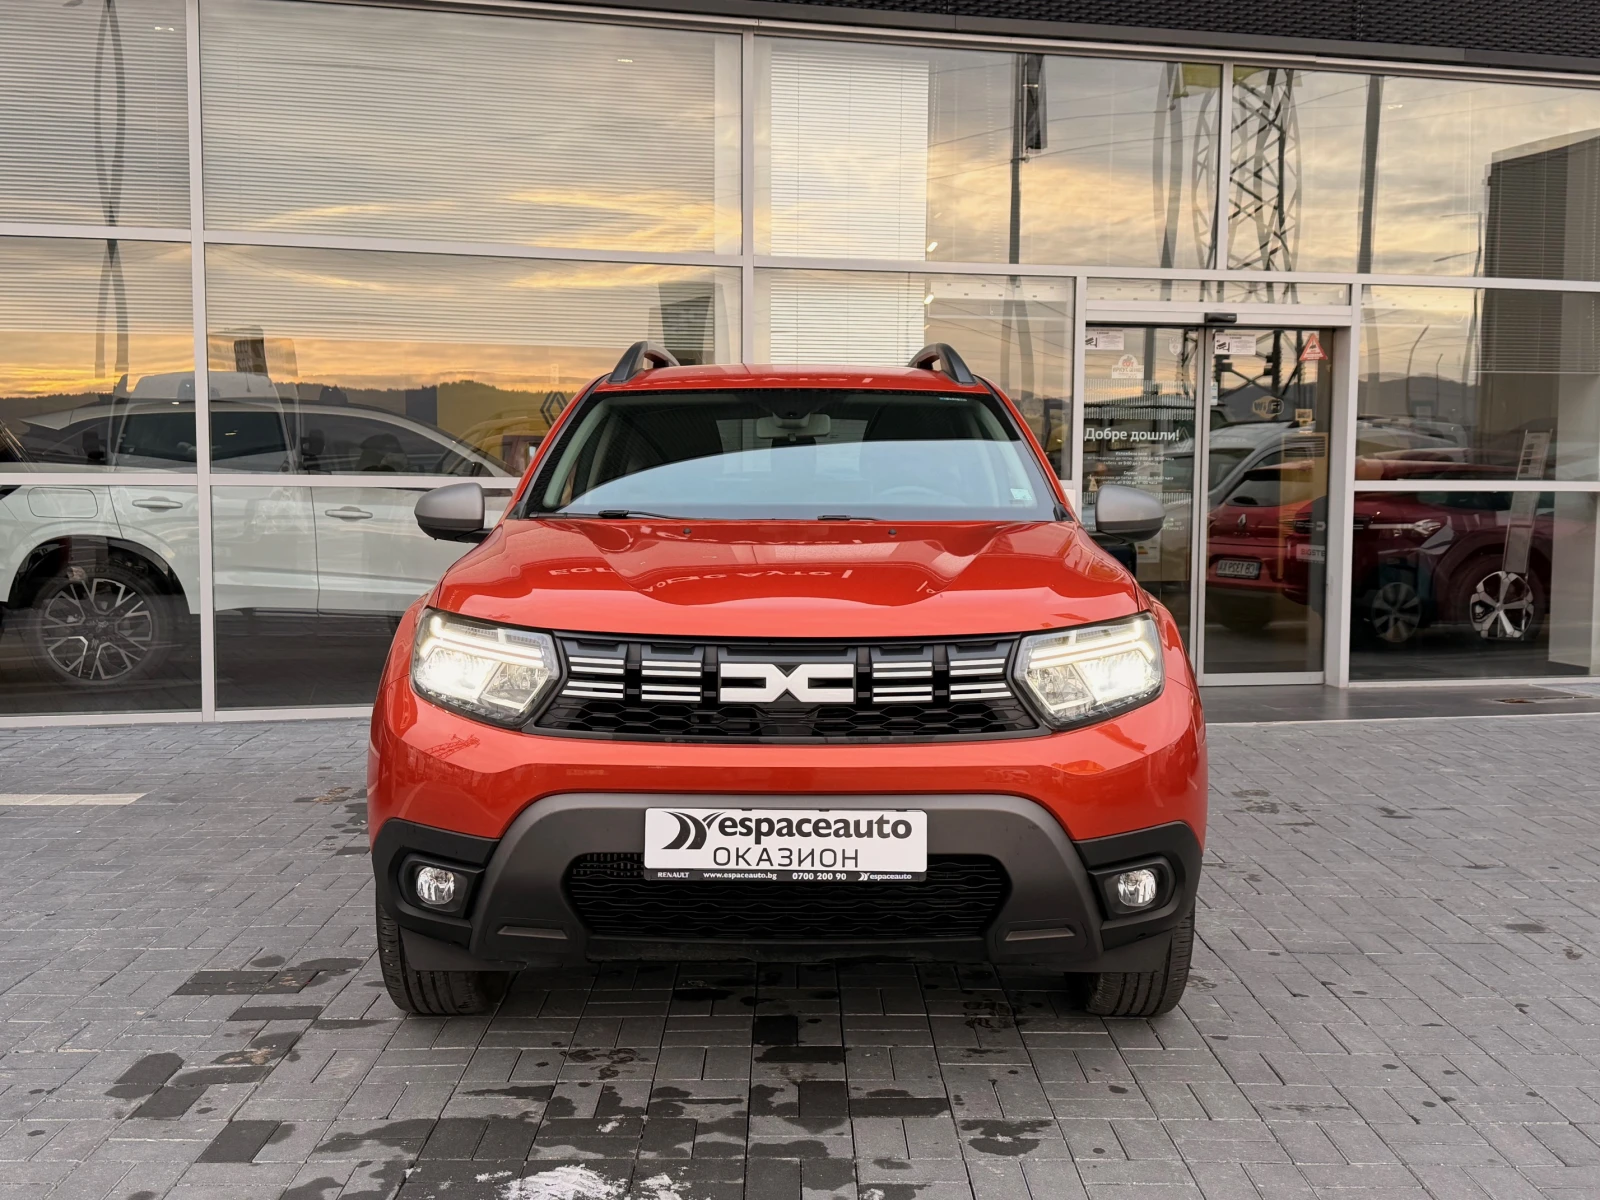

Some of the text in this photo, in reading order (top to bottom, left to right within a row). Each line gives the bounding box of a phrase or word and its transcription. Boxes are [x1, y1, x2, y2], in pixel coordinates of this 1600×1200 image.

[1084, 428, 1180, 442] Добре дошли!
[718, 814, 912, 845] espaceauto
[713, 846, 859, 868] ОКАЗИОН
[657, 871, 912, 881] RENAULT www.espaceauto.bg 0700 200 90 espaceauto
